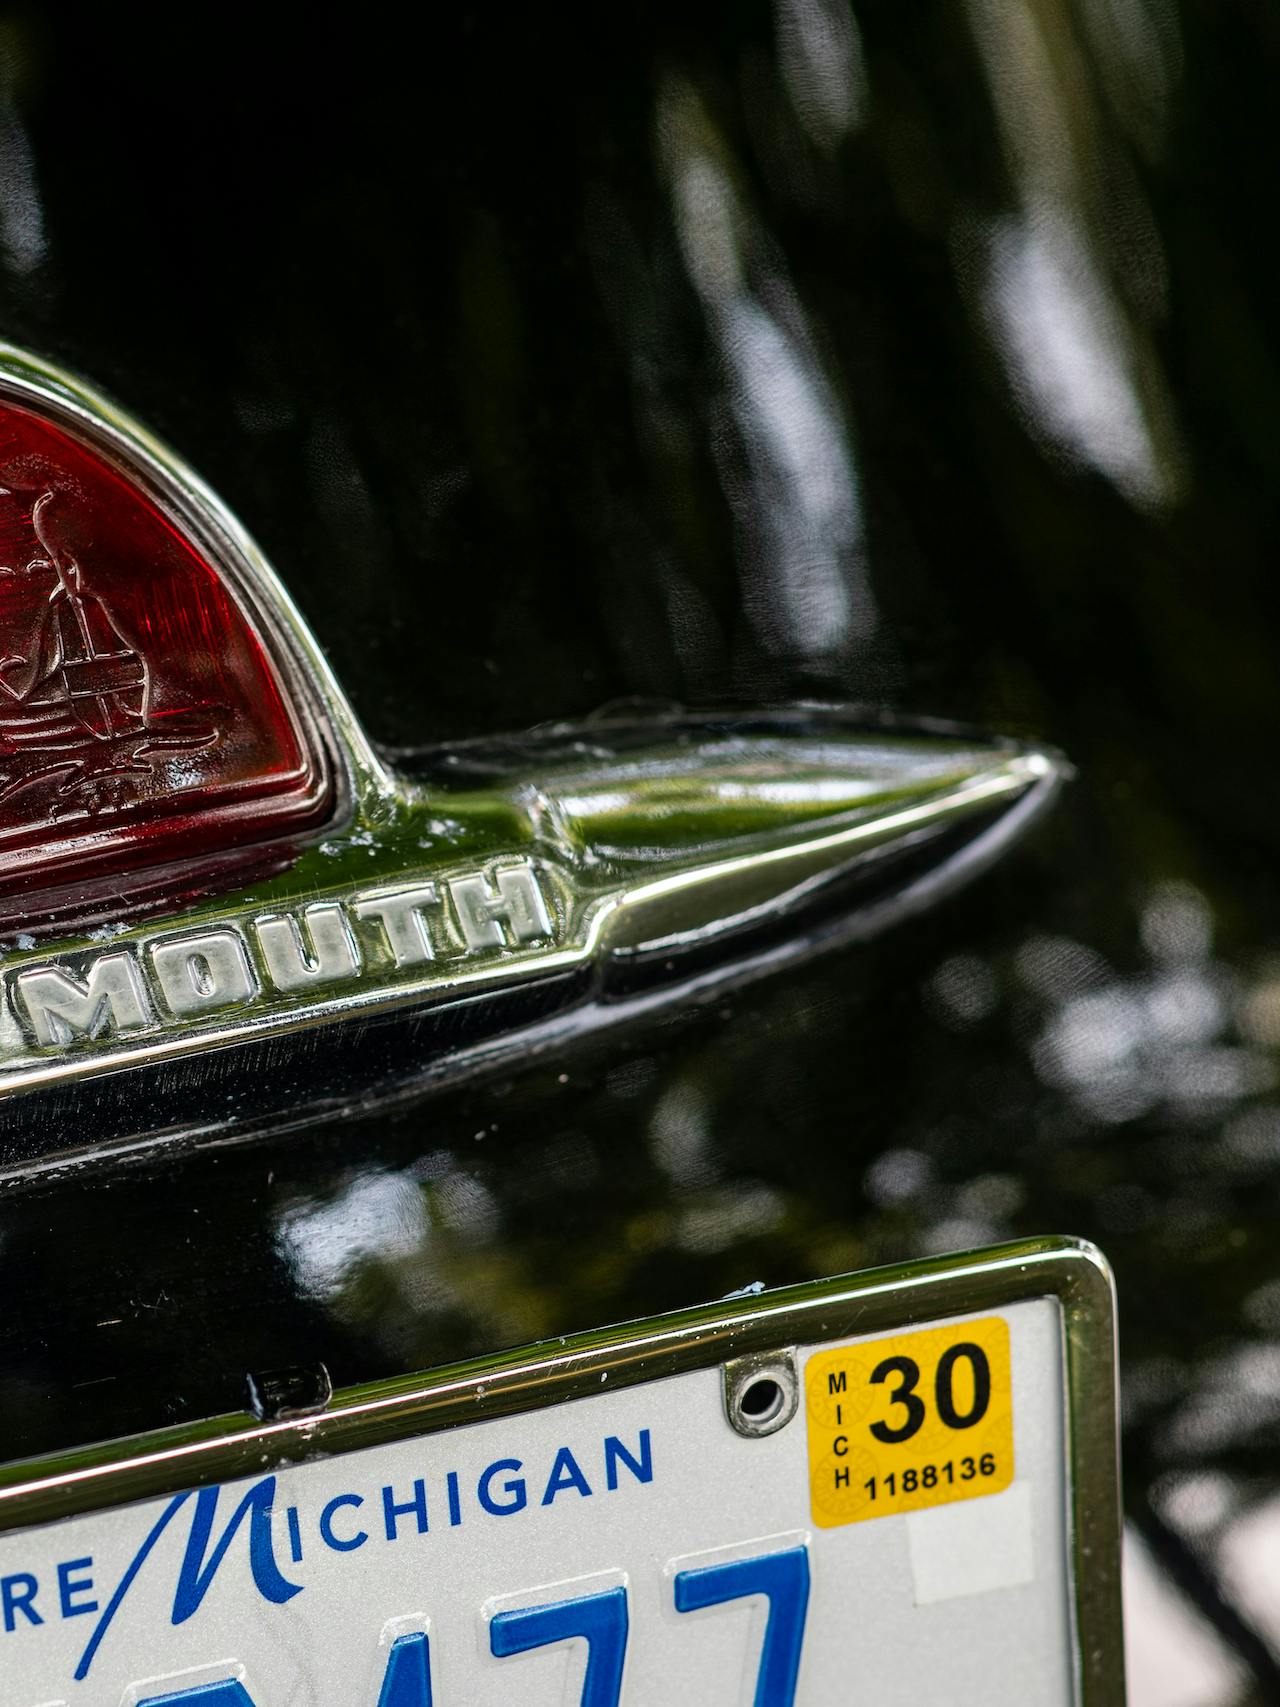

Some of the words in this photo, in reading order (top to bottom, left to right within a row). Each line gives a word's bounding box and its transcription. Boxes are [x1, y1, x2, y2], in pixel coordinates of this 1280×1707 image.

[828, 1371, 850, 1489] MICH
[869, 1342, 991, 1444] 30
[863, 1453, 996, 1500] 1188136
[74, 1429, 654, 1681] MICHIGAN
